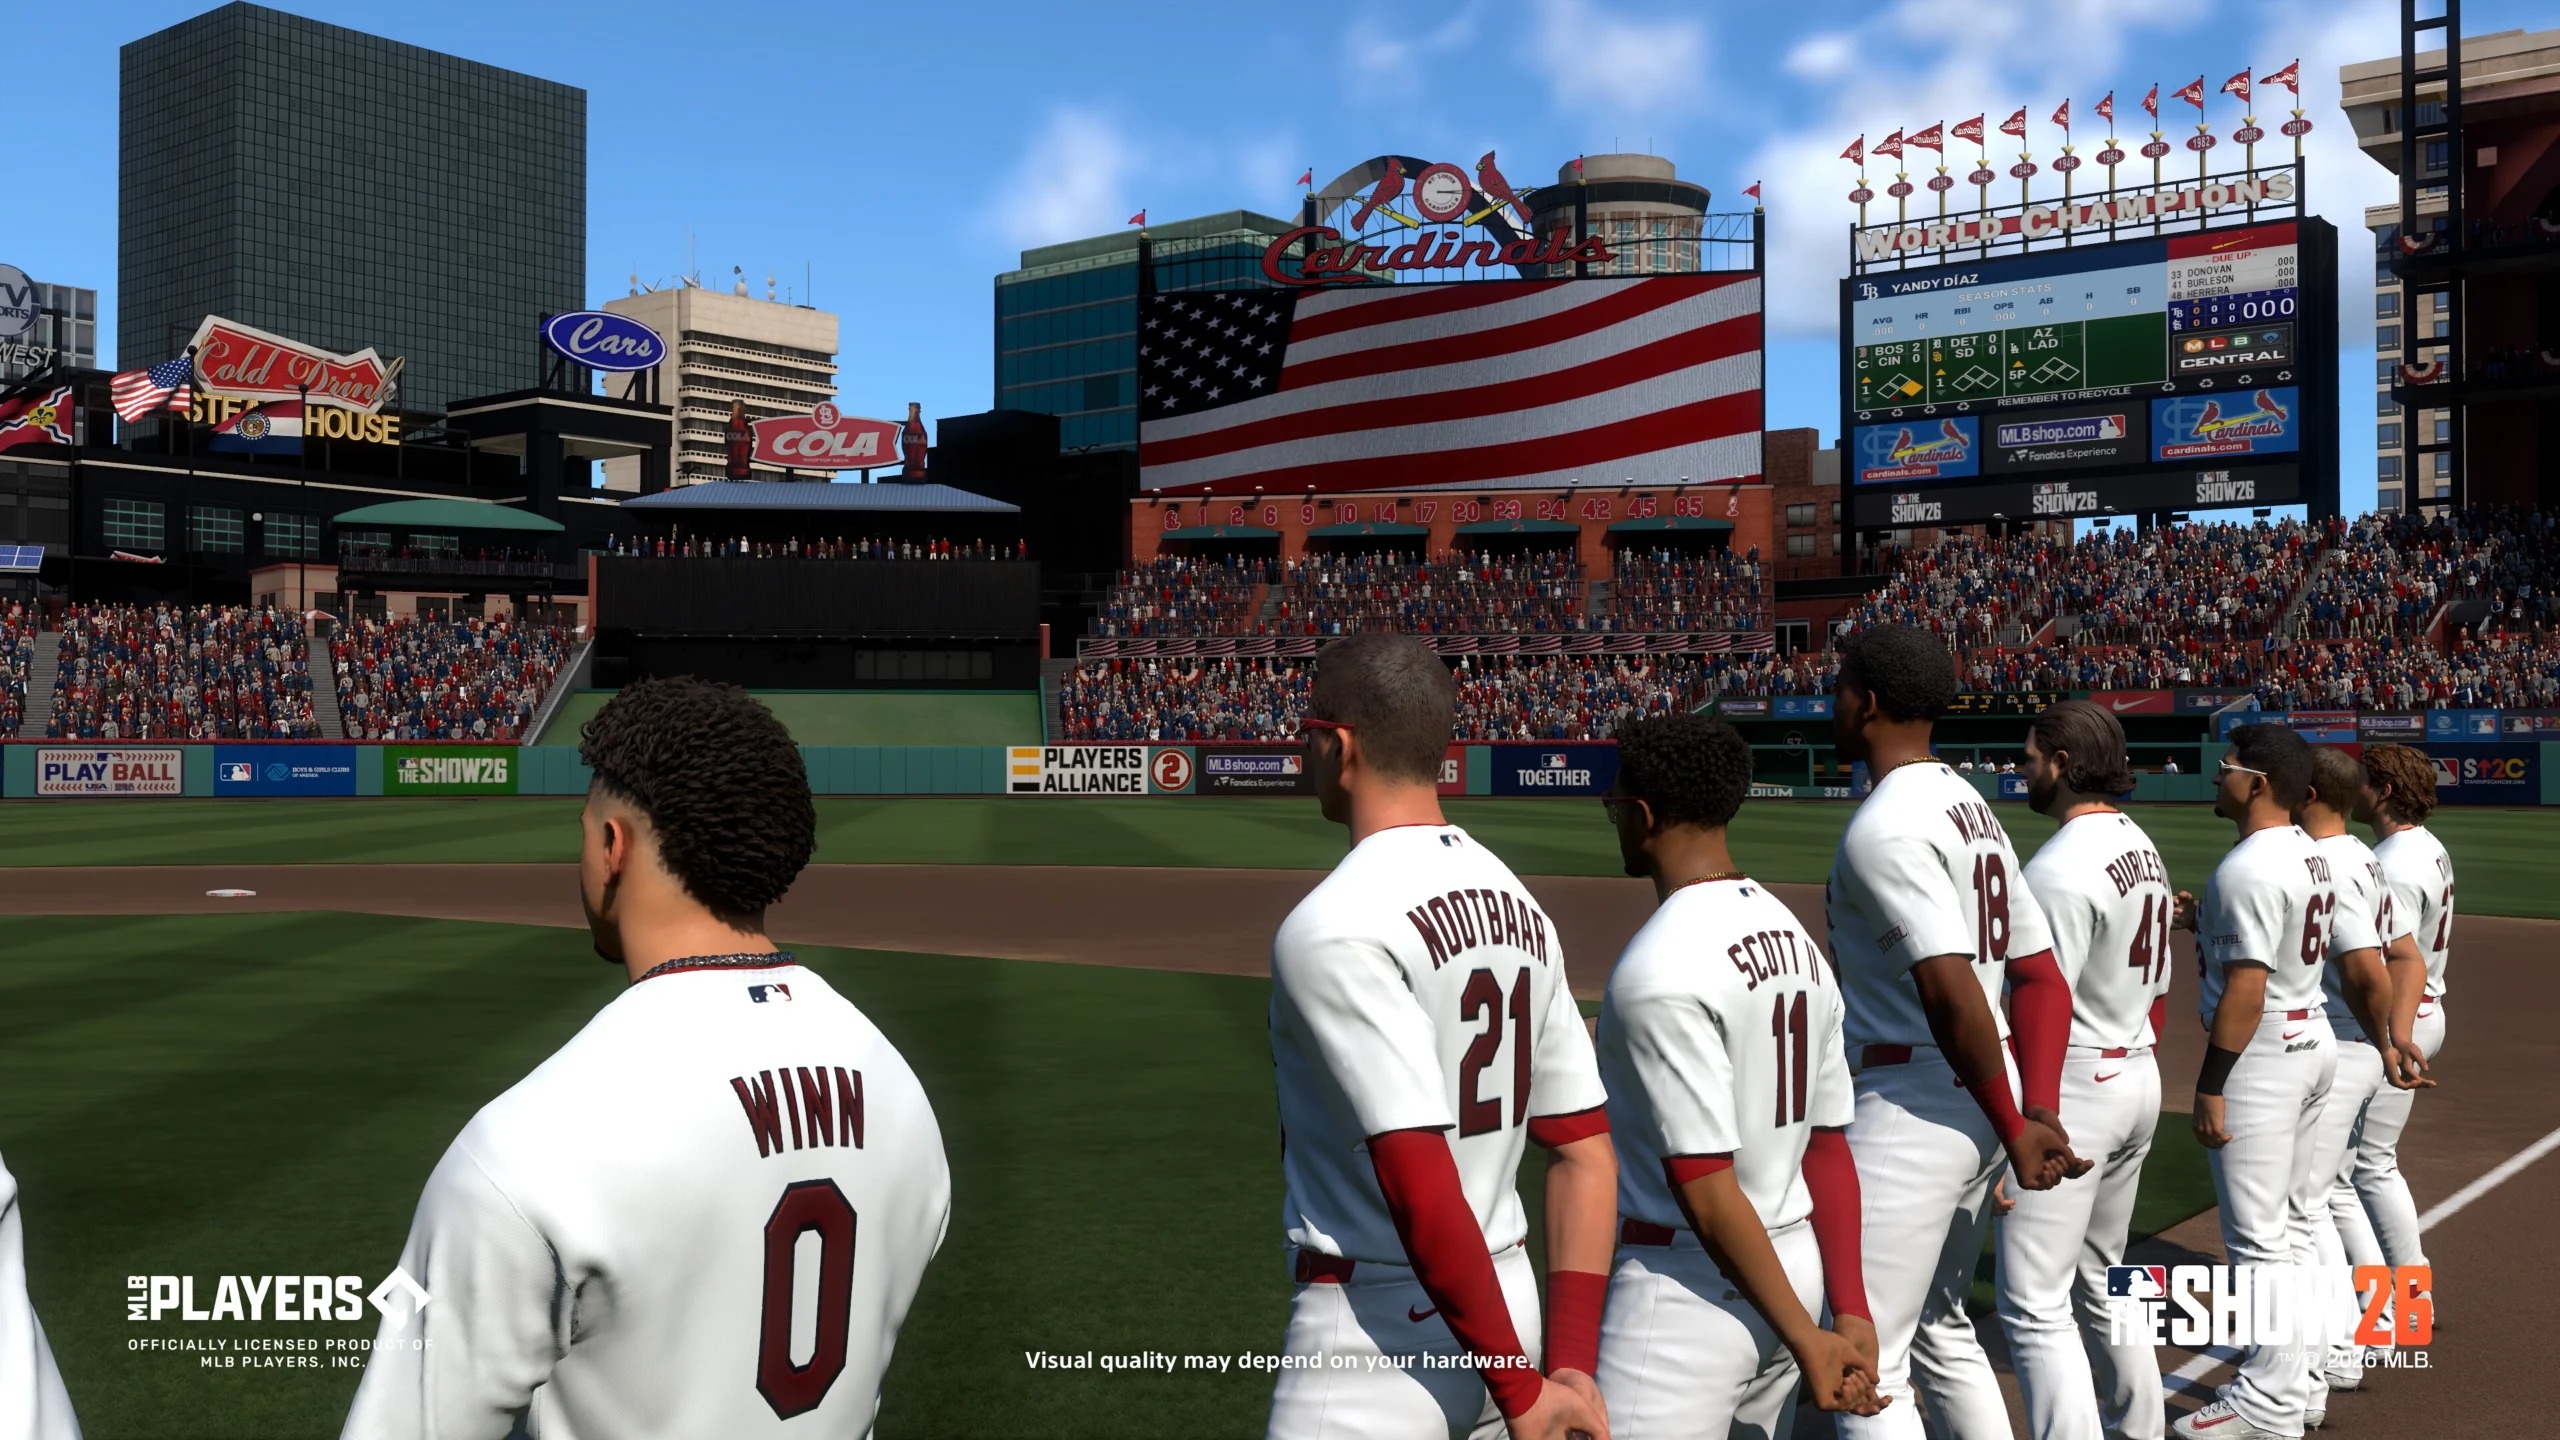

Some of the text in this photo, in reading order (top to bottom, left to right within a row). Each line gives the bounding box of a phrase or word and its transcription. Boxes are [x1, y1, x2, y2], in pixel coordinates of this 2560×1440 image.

[2240, 129, 2257, 141] 2006
[2287, 121, 2305, 133] 2011
[2148, 144, 2163, 155] 1967
[2193, 137, 2210, 148] 1982
[2058, 157, 2074, 168] 1946
[2103, 151, 2119, 162] 1964
[1973, 172, 1988, 182] 1942
[2015, 166, 2031, 175] 1944
[1892, 185, 1907, 194] 1931
[1932, 179, 1947, 188] 1934
[1853, 191, 1868, 200] 1926
[1855, 174, 2294, 261] WORLD CHAMPIONS
[1261, 225, 1620, 285] Cardinals
[2212, 251, 2251, 263] DUE UP
[2171, 256, 2294, 280] 33 DONOVAN .000
[1891, 274, 1979, 293] YANDY DÍAZ
[2172, 267, 2294, 289] 41 BURLESON .000
[1958, 283, 2052, 302] SEASON STATS
[2171, 277, 2294, 300] 48 HERRERA .000
[1872, 317, 1893, 325] AVG
[1915, 312, 1929, 320] HR
[1954, 307, 1971, 315] RBI
[1993, 302, 2014, 310] OPS
[2039, 297, 2053, 305] AB
[1992, 312, 2016, 322] .000
[568, 317, 654, 359] Cars
[1950, 335, 1979, 348] DET
[1988, 334, 1996, 344] 0
[2033, 327, 2053, 339] AZ
[1875, 345, 1904, 356] BOS
[1912, 343, 1920, 352] 2
[1955, 347, 1974, 358] SD
[1988, 345, 1997, 355] 0
[2028, 339, 2058, 350] LAD
[1878, 354, 1920, 366] CIN 0
[2180, 350, 2285, 368] CENTRAL
[194, 335, 406, 402] Cold Drink
[1862, 386, 1870, 395] 1
[1936, 378, 1944, 387] 1
[1998, 387, 2131, 407] REMEMBER TO RECYCLE
[304, 405, 400, 446] HOUSE
[2207, 420, 2282, 443] Cardinals
[726, 432, 750, 441] COLA
[903, 434, 926, 444] COLA
[2001, 425, 2095, 444] MLBshop.com
[772, 430, 880, 457] COLA
[2167, 443, 2242, 455] cardinals.com
[1901, 446, 1966, 467] Cardinals
[2029, 447, 2117, 461] Fanatics Experience
[1867, 468, 1931, 479] cardinals.com
[2215, 471, 2229, 482] THE
[2054, 482, 2069, 493] THE
[2196, 480, 2255, 503] SHOW26
[1908, 493, 1920, 503] THE
[2033, 491, 2097, 514] SHOW26
[1199, 507, 1206, 526] 1
[1231, 506, 1244, 526] 2
[1264, 505, 1277, 525] 6
[1302, 504, 1314, 525] 9
[1335, 503, 1357, 524] 10
[1374, 502, 1396, 523] 14
[1415, 501, 1437, 522] 17
[1452, 501, 1480, 522] 20
[1493, 500, 1521, 520] 23
[1536, 499, 1565, 520] 24
[1582, 499, 1611, 519] 42
[1628, 497, 1656, 519] 45
[1675, 496, 1703, 517] 85
[1892, 502, 1941, 523] SHOW26
[2361, 719, 2409, 728] MLBshop.com
[1044, 748, 1142, 769] PLAYERS
[1209, 759, 1280, 773] MLBshop.com
[44, 764, 174, 781] PLAY BALL
[398, 758, 507, 783] THE SHOW26
[1162, 755, 1180, 784] 2
[1517, 769, 1591, 786] TOGETHER
[1044, 773, 1142, 792] ALLIANCE
[1230, 779, 1295, 788] Fanatics Experience
[1745, 787, 1793, 797] DIUM
[2105, 850, 2170, 898] BURLES
[1973, 853, 2010, 964] 18
[1406, 889, 1547, 971] NOOTBAAR
[2128, 893, 2168, 985] 41
[2211, 934, 2242, 946] STIFEL
[1728, 930, 1820, 991] SCOTT II
[1459, 966, 1532, 1140] 21
[1772, 990, 1808, 1129] 11
[730, 1066, 864, 1159] WINN
[756, 1178, 857, 1421] 0
